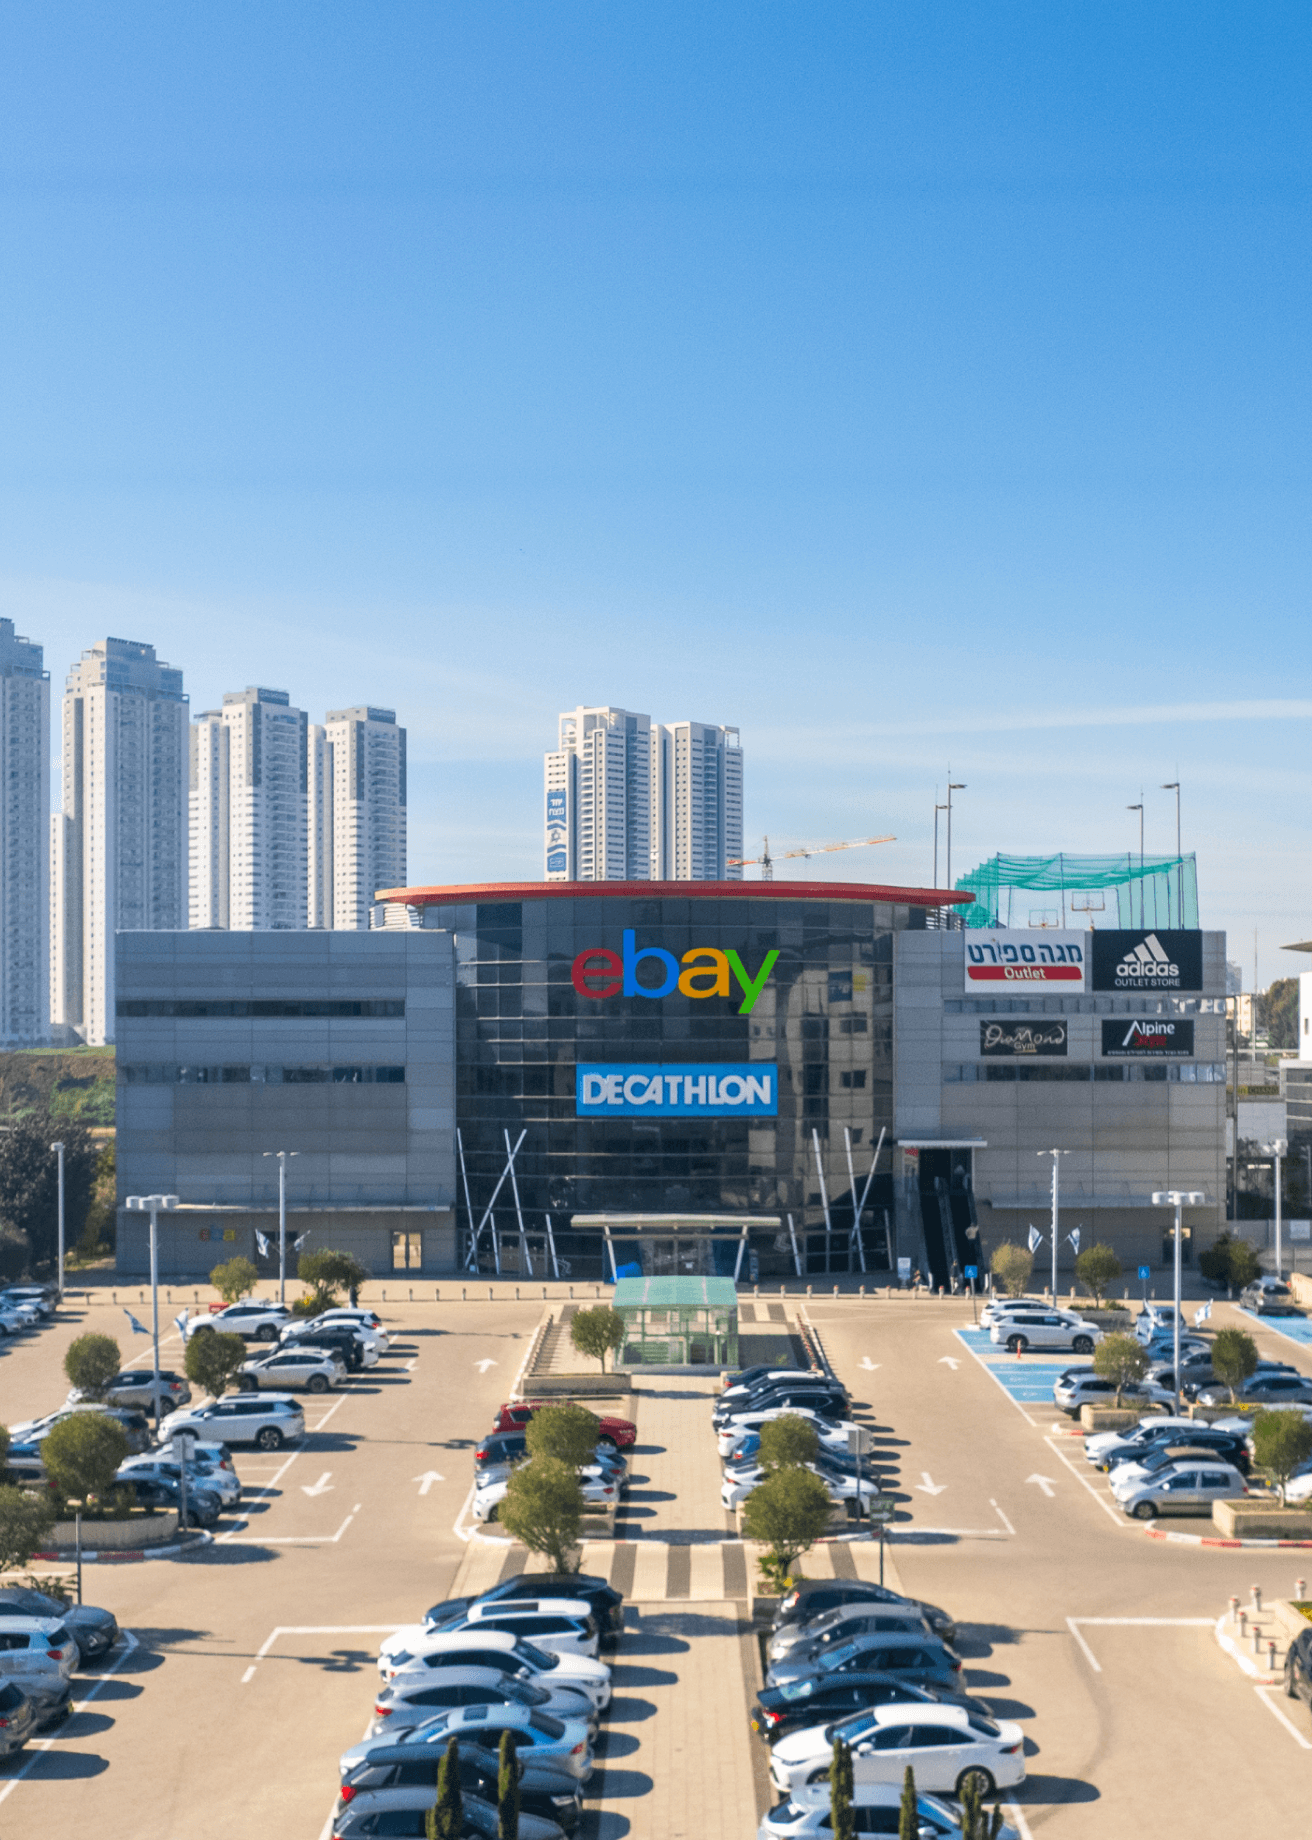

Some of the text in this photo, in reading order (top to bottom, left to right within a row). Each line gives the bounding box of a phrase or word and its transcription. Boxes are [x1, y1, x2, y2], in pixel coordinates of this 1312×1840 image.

[1038, 944, 1083, 963] מגה
[571, 929, 780, 1014] ebay
[1004, 966, 1047, 980] Outlet
[1116, 960, 1180, 977] adidas
[1114, 977, 1181, 987] OUTLET STORE
[1122, 1020, 1175, 1046] Alpine
[1013, 1040, 1036, 1051] Gym
[582, 1074, 772, 1105] DECATHLON
